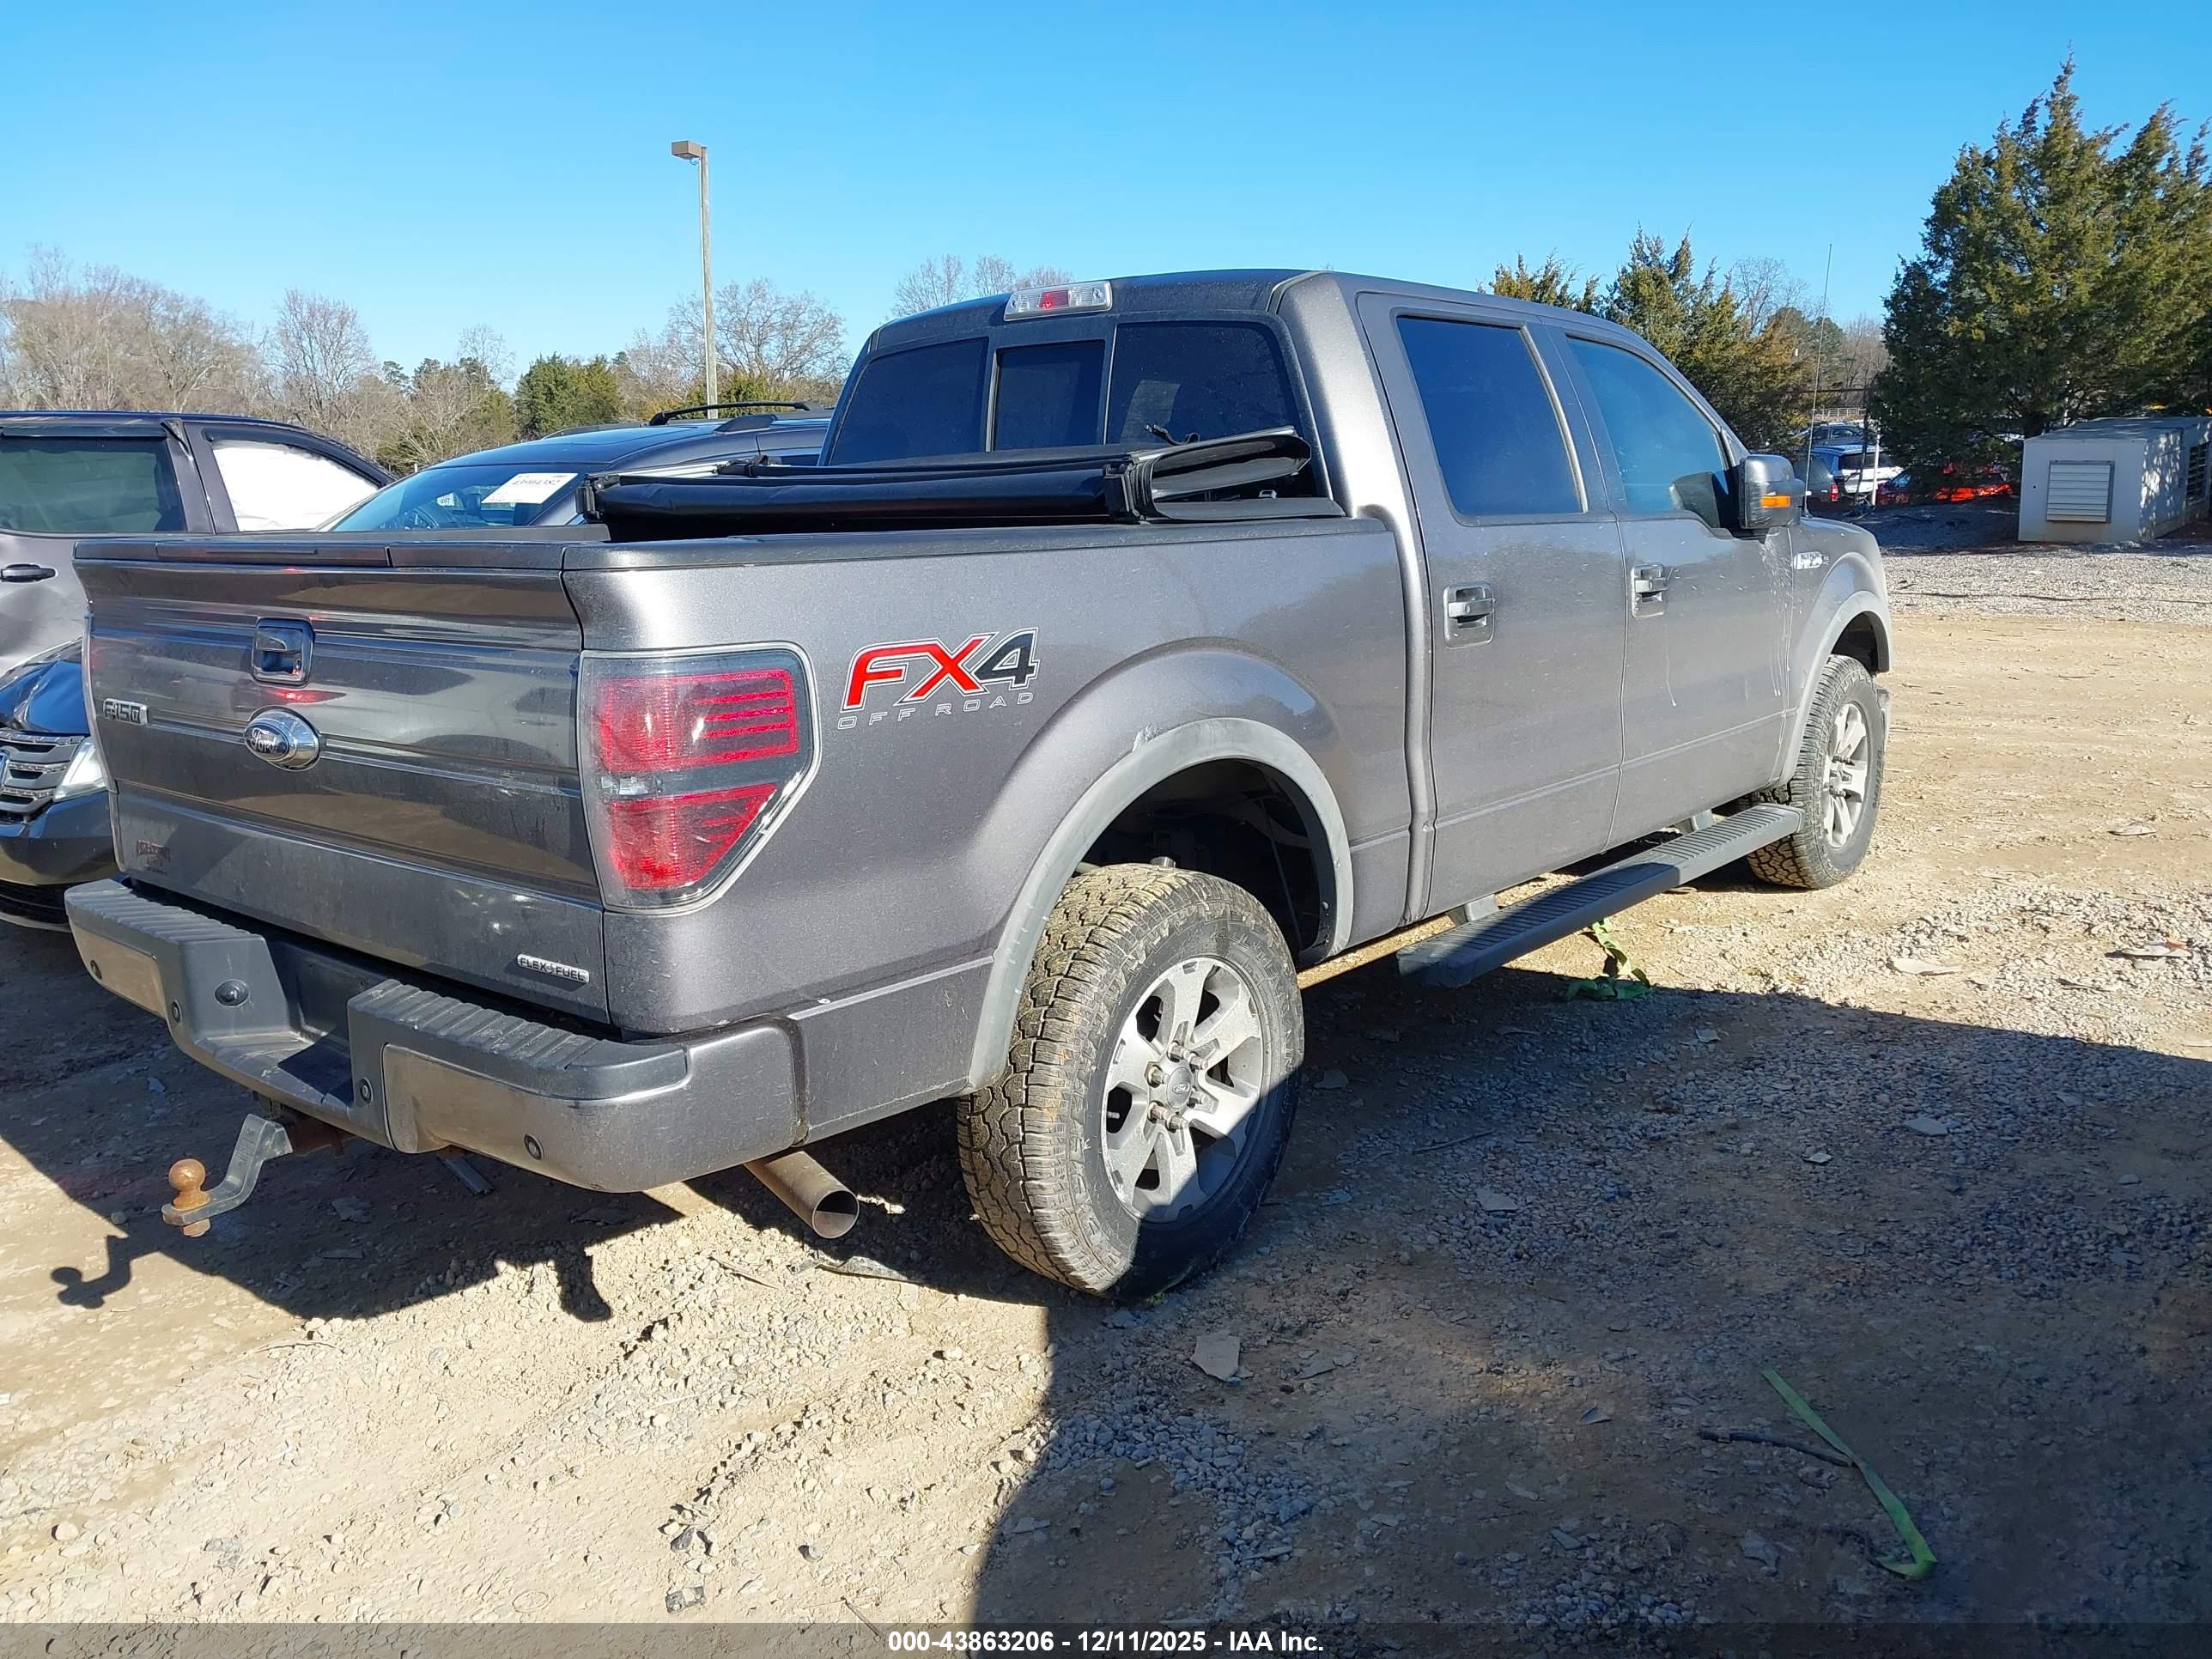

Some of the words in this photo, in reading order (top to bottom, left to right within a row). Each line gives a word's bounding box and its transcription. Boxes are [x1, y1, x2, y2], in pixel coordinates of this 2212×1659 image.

[840, 627, 1041, 714] FX4
[837, 708, 916, 730] OFF
[935, 692, 1034, 716] ROAD
[250, 727, 277, 753] Ford
[520, 957, 548, 973] FLEX
[556, 965, 586, 981] FUEL
